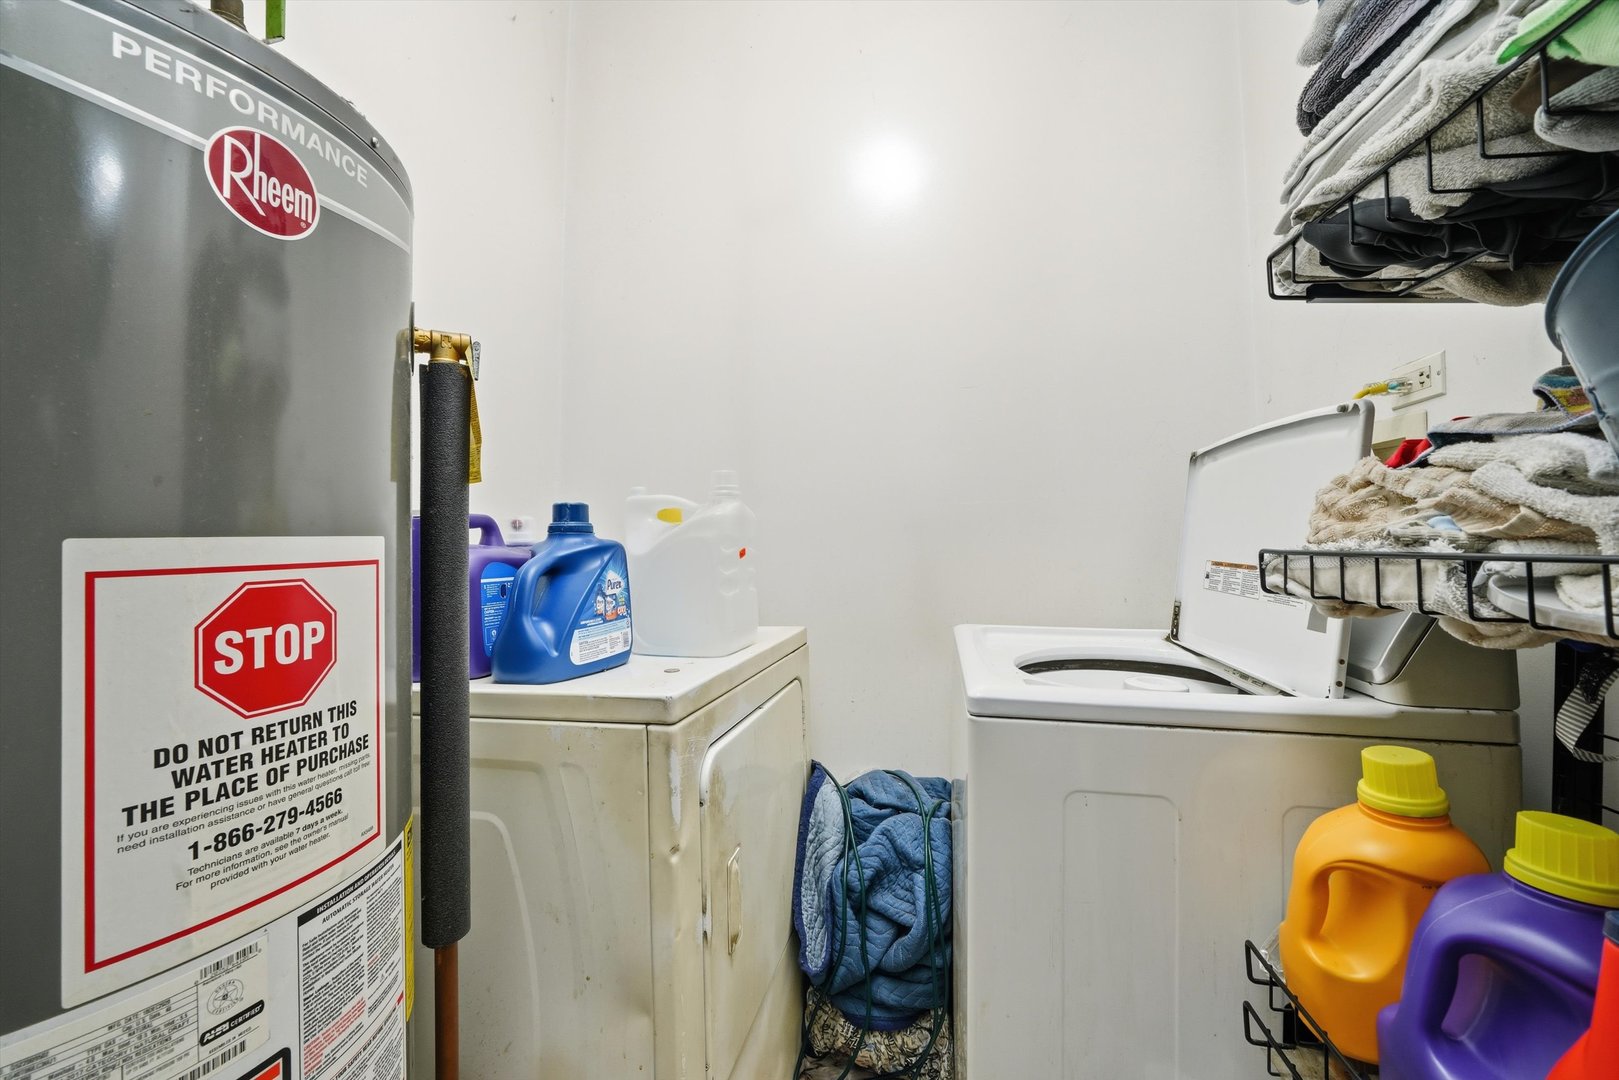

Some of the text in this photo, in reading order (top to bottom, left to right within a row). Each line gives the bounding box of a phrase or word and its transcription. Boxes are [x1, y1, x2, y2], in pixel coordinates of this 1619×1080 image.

[112, 31, 369, 189] PERFORMANCE
[223, 131, 315, 217] Rheem
[213, 620, 326, 676] STOP
[153, 700, 358, 769] DO NOT RETURN THIS
[171, 722, 350, 790] WATER HEATER TO
[117, 833, 125, 842] If
[128, 829, 148, 842] you
[151, 823, 169, 834] are
[172, 804, 235, 829] experiencing
[236, 794, 264, 809] issues
[265, 788, 282, 799] with
[283, 782, 296, 793] this
[298, 776, 316, 788] water
[338, 758, 358, 771] missing
[117, 839, 146, 854] need
[149, 823, 205, 845] installation
[207, 807, 256, 828] assistance
[257, 802, 266, 811] or
[267, 795, 286, 807] have
[288, 786, 314, 802] general
[315, 773, 343, 790] questions
[343, 768, 353, 777] call
[353, 764, 361, 773] toll
[121, 734, 370, 827] THE PLACE OF PURCHASE
[176, 813, 349, 890] For more information, see the owner's manual
[187, 788, 343, 861] 1-866-279-4566
[187, 852, 243, 876] Technicians
[245, 845, 259, 856] are
[260, 832, 295, 849] available
[296, 827, 301, 835] 7
[302, 820, 319, 832] days
[325, 809, 343, 821] week.
[210, 833, 331, 890] provided with your water heater.
[316, 883, 354, 914] INSTALLATION
[322, 900, 352, 924] AUTOMATIC
[352, 885, 371, 904] STORAGE
[371, 874, 384, 888] WATER
